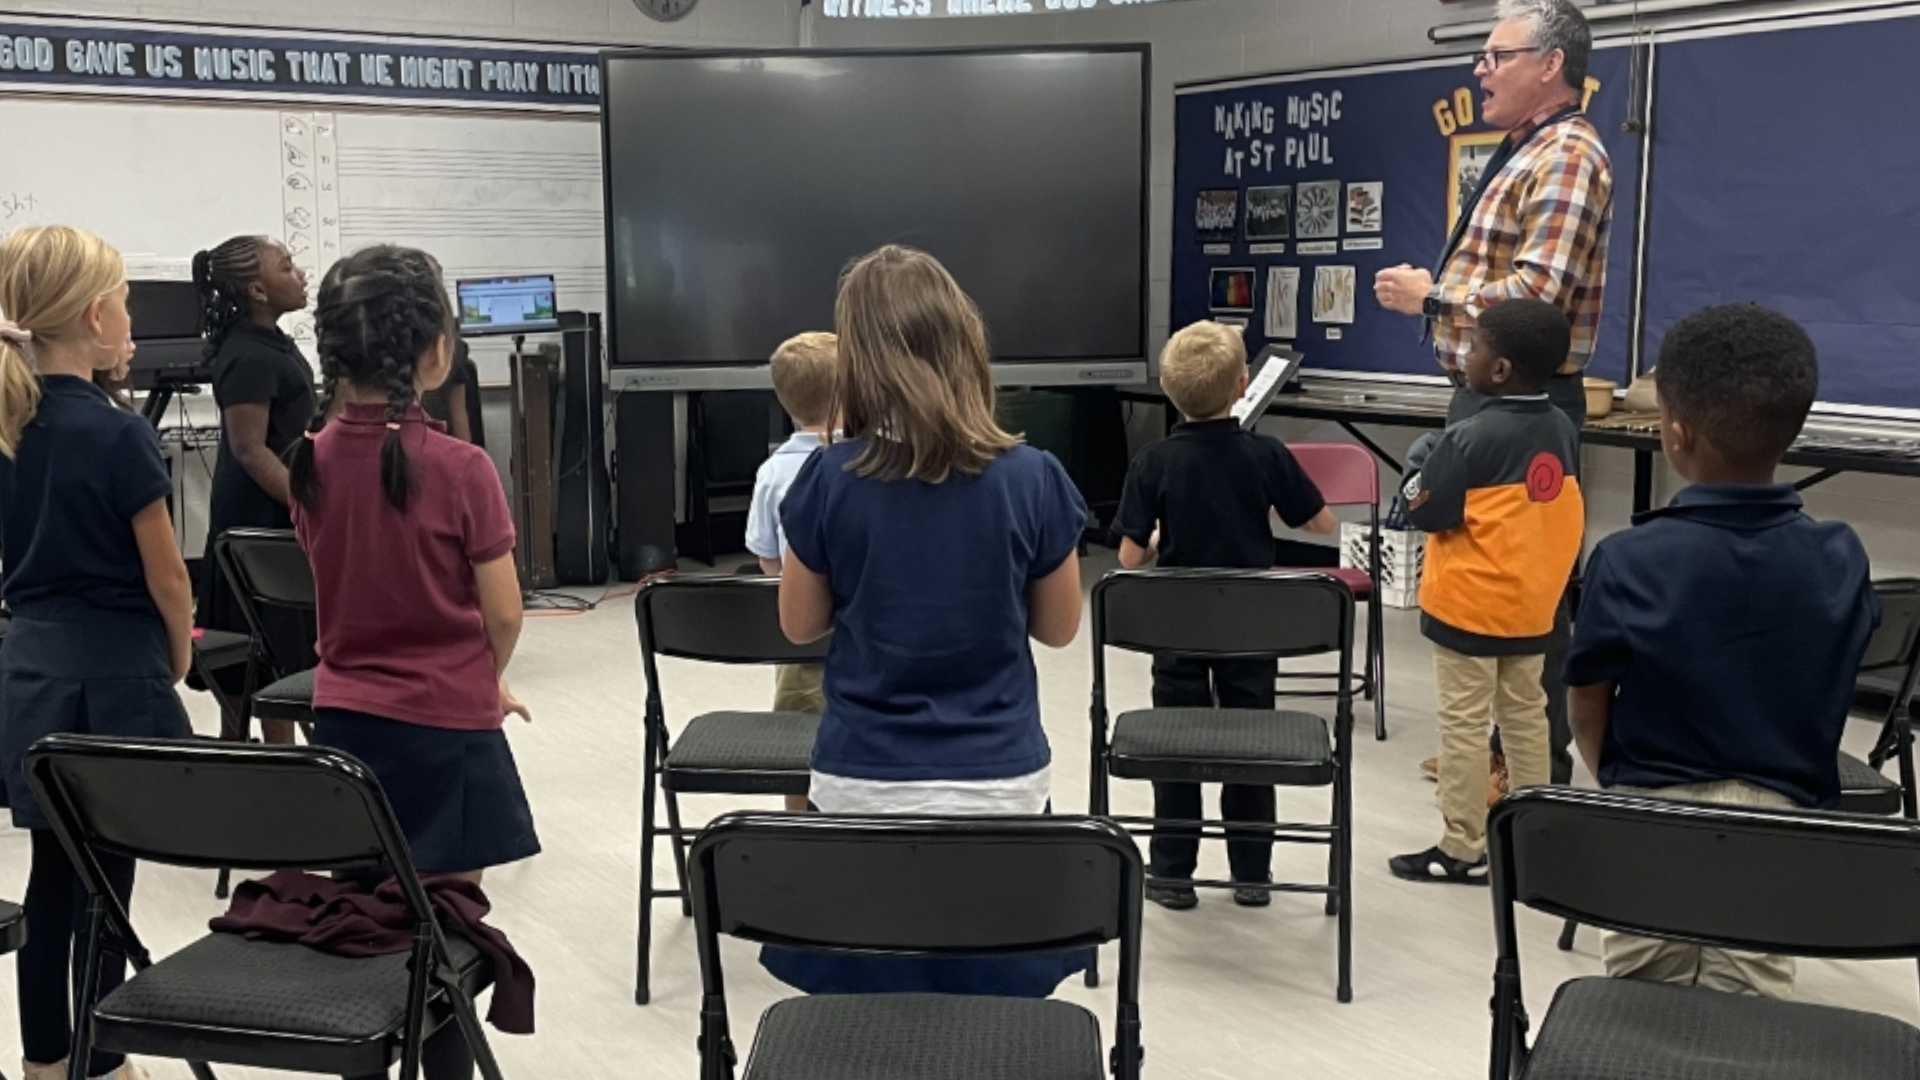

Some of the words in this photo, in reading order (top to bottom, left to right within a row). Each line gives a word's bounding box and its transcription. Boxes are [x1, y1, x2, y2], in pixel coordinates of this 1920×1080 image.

[0, 35, 54, 72] GOD
[65, 39, 136, 76] GAVE
[145, 44, 183, 78] US
[193, 46, 276, 82] MUSIC
[285, 51, 351, 84] THAT
[359, 53, 395, 87] WE
[400, 56, 474, 89] MIGHT
[480, 60, 540, 92] PRAY
[547, 63, 600, 95] WITH
[1214, 101, 1275, 140] MAKING
[1286, 90, 1342, 130] MUSIC
[1224, 147, 1245, 179] AT
[1250, 139, 1275, 172] ST
[1285, 132, 1334, 169] PAUL
